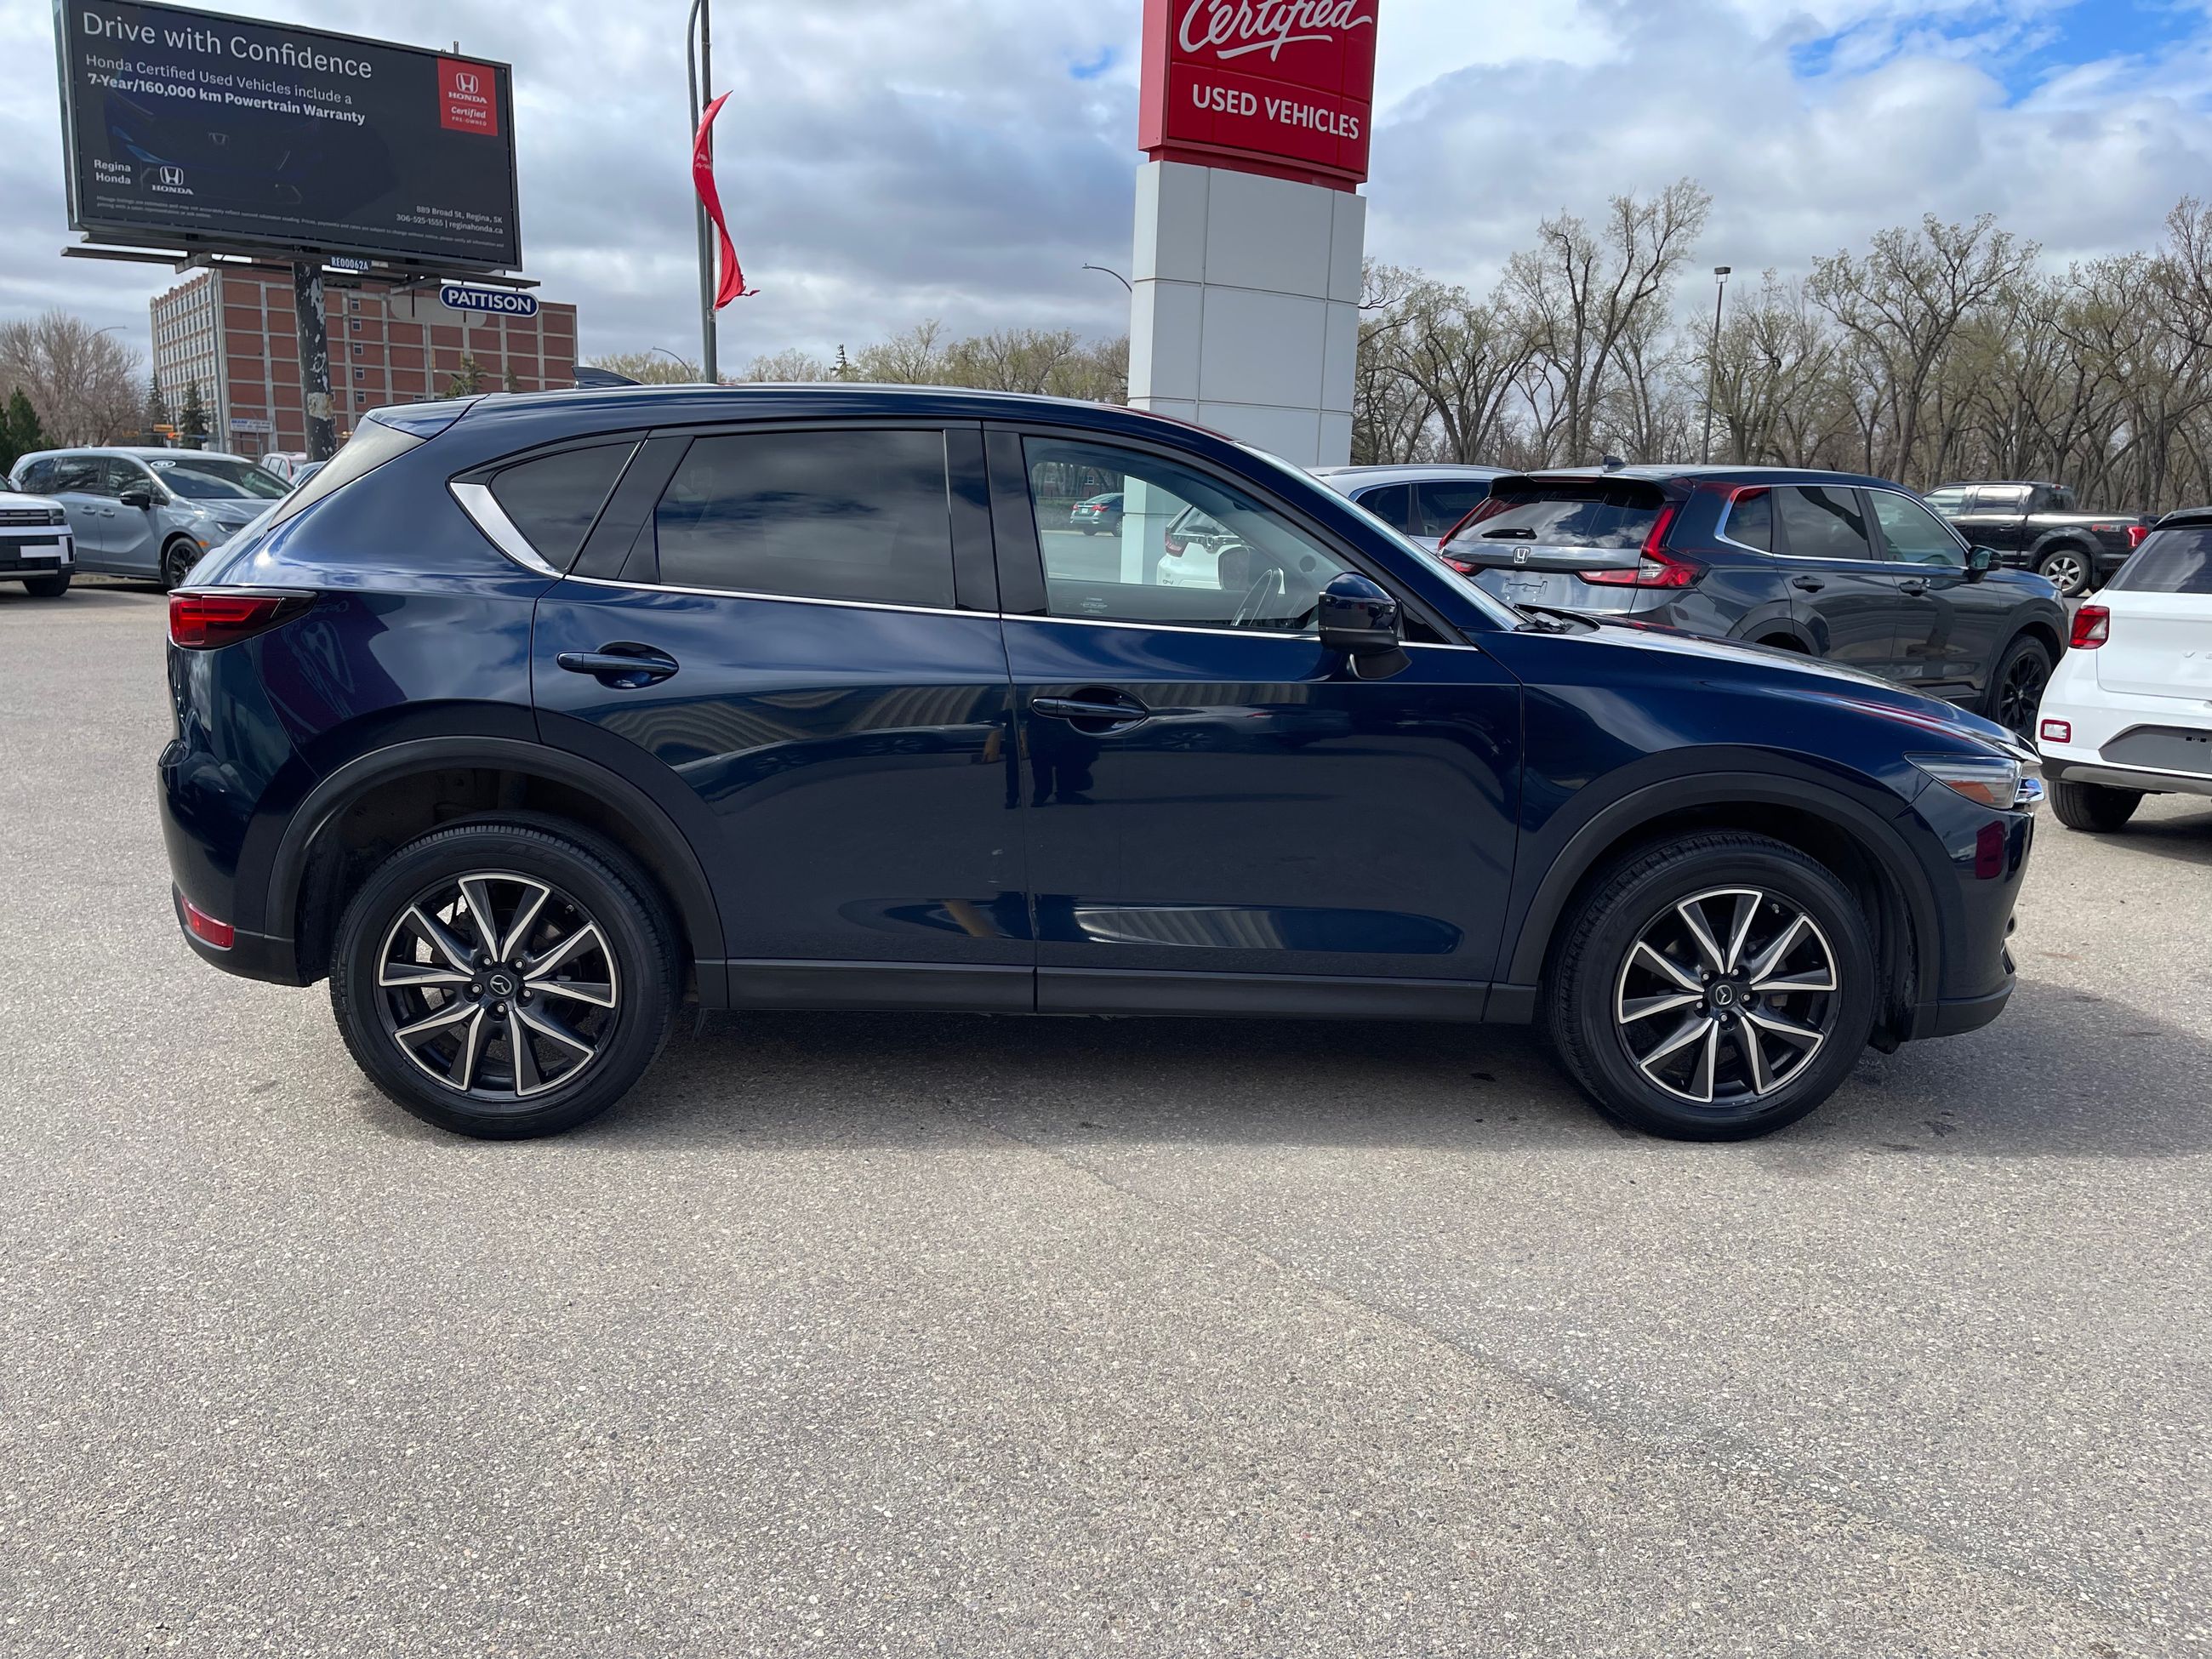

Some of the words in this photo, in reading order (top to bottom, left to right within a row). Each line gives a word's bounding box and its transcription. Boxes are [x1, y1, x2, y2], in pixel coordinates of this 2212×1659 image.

[1179, 0, 1372, 62] Certified
[83, 11, 156, 44] Drive
[163, 27, 221, 55] with
[230, 36, 372, 79] Confidence
[85, 54, 133, 72] Honda
[136, 61, 196, 82] Certified
[199, 71, 233, 86] Used
[237, 76, 291, 95] Vehicles
[294, 84, 341, 103] include
[345, 94, 352, 105] a
[87, 73, 197, 99] 7-Year/160,000
[199, 88, 221, 103] km
[225, 93, 300, 114] Powertrain
[303, 104, 366, 127] Warranty
[448, 91, 487, 104] HONDA
[451, 106, 487, 118] Certified
[1193, 83, 1257, 117] USED
[1264, 96, 1360, 140] VEHICLES
[94, 159, 131, 173] Regina
[95, 172, 131, 185] Honda
[151, 185, 194, 195] HONDA
[431, 207, 453, 218] Broad
[493, 215, 504, 224] SK
[448, 221, 504, 235] reginahonda.ca
[448, 289, 532, 313] PATTISON
